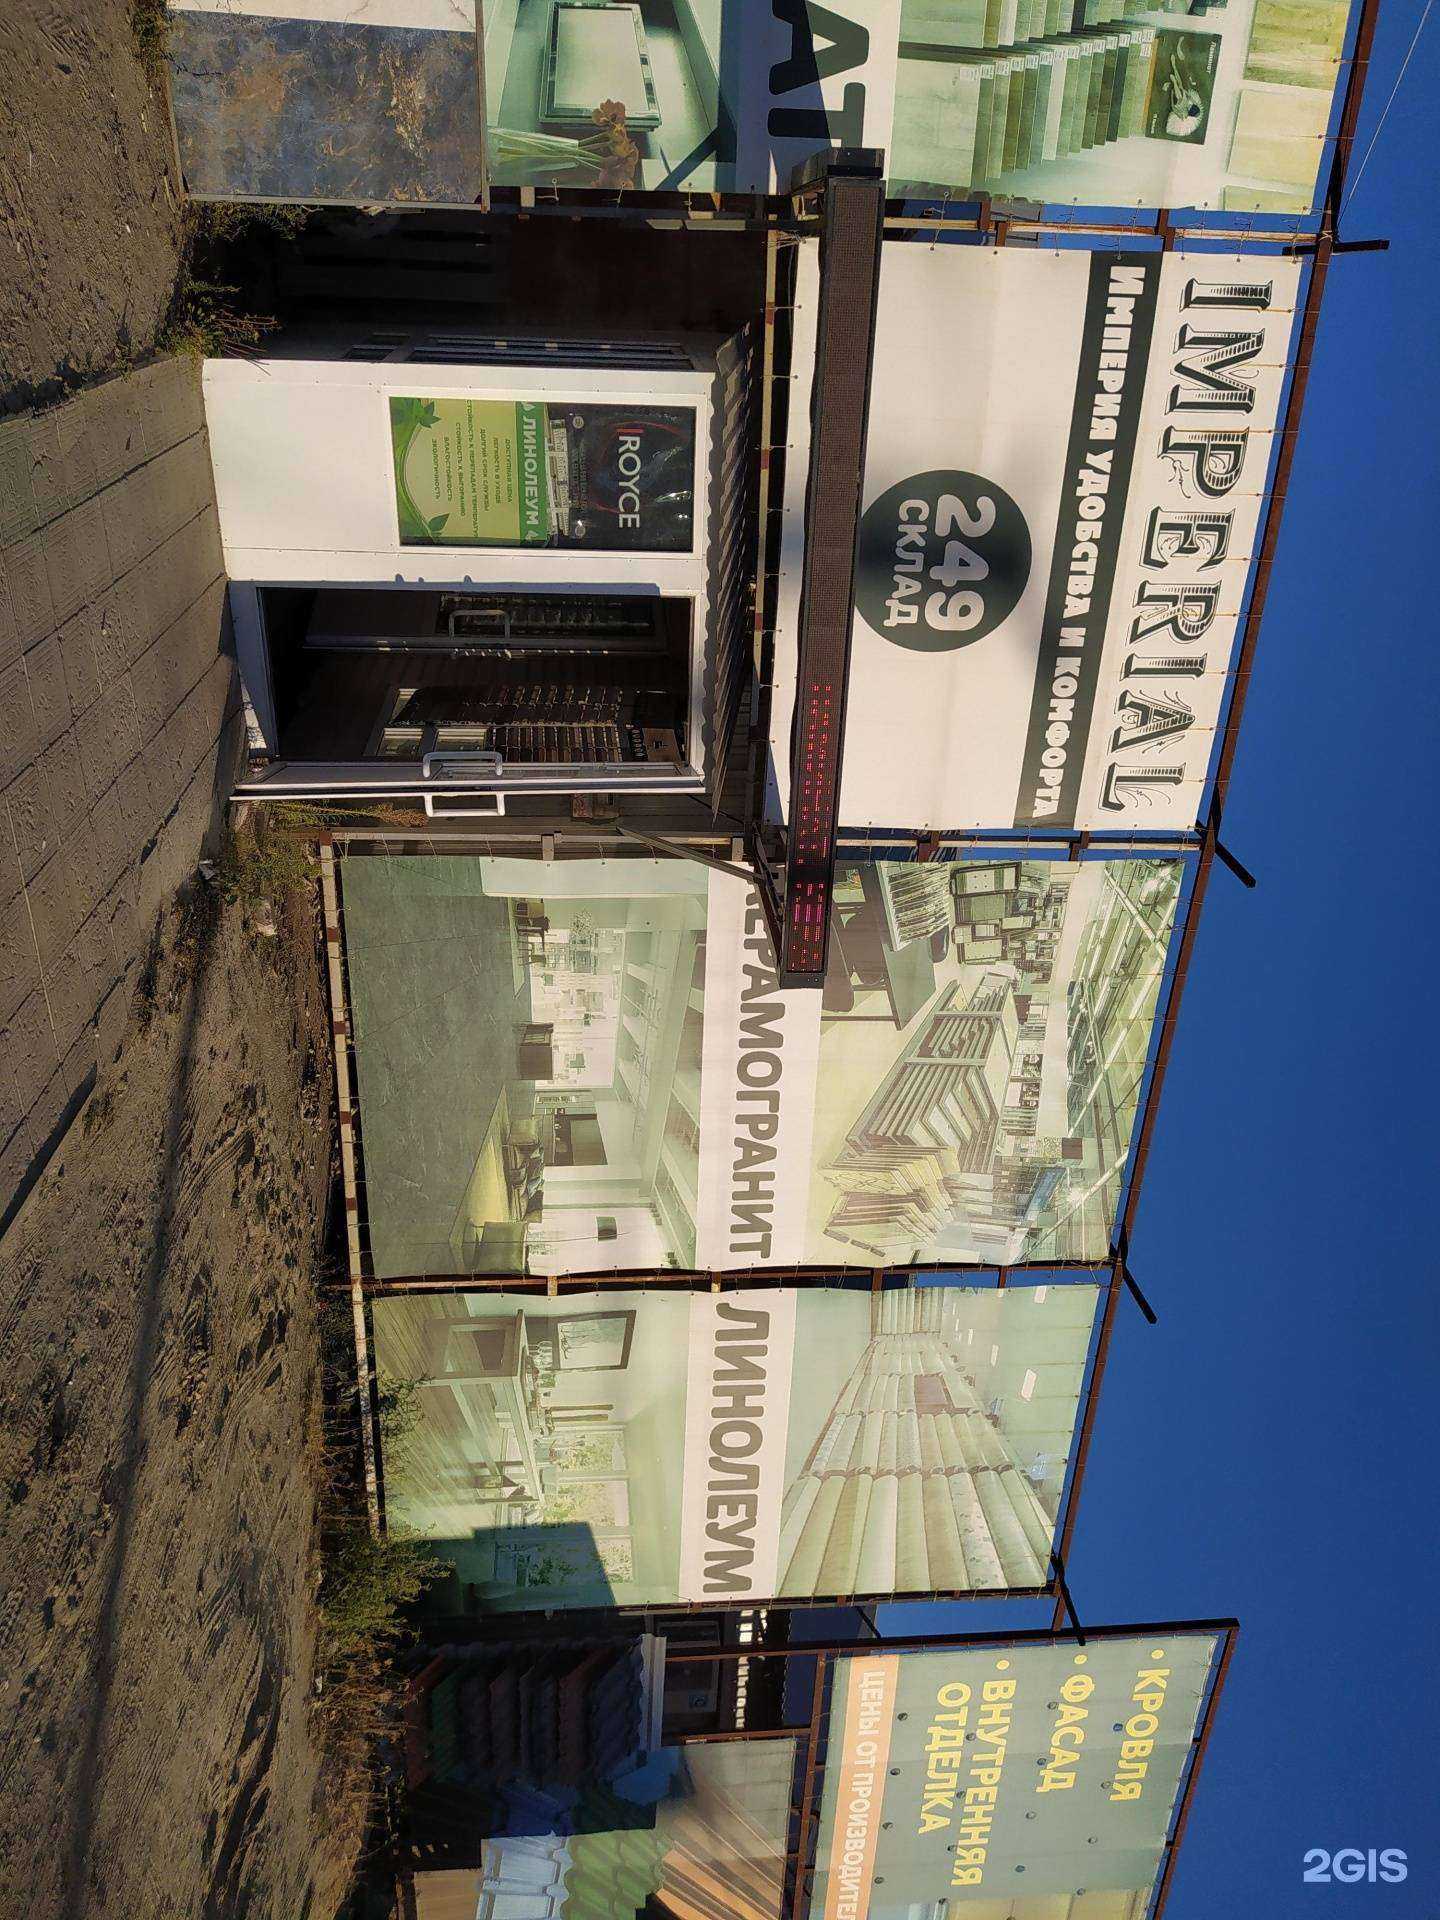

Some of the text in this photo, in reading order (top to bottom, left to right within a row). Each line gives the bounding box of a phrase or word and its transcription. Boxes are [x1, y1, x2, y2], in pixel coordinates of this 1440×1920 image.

[432, 438, 440, 500] ЭКОЛОГИЧНОСТЬ
[444, 437, 453, 501] ВЛАГОСТОЙКОСТЬ
[480, 428, 488, 458] ДОЛГИЙ
[523, 416, 539, 525] ЛИНОЛЕУМ
[617, 435, 642, 528] ROYCE
[883, 499, 930, 627] СКЛАД
[924, 494, 997, 632] 249
[1031, 266, 1146, 819] ИМПЕРИЯ УДОБСТВА И КОМФОРТА
[1097, 278, 1274, 815] IMPERIAL
[702, 1302, 771, 1593] ЛИНОЛЕУМ
[854, 1741, 877, 1768] ОТ
[856, 1670, 886, 1736] ЦЕНЫ
[918, 1683, 970, 1834] ОТДЕЛКА
[1036, 1674, 1095, 1792] ФАСАД
[1110, 1669, 1170, 1801] КРОВЛЯ
[952, 1679, 1016, 1886] ВНУТРЕННЯЯ
